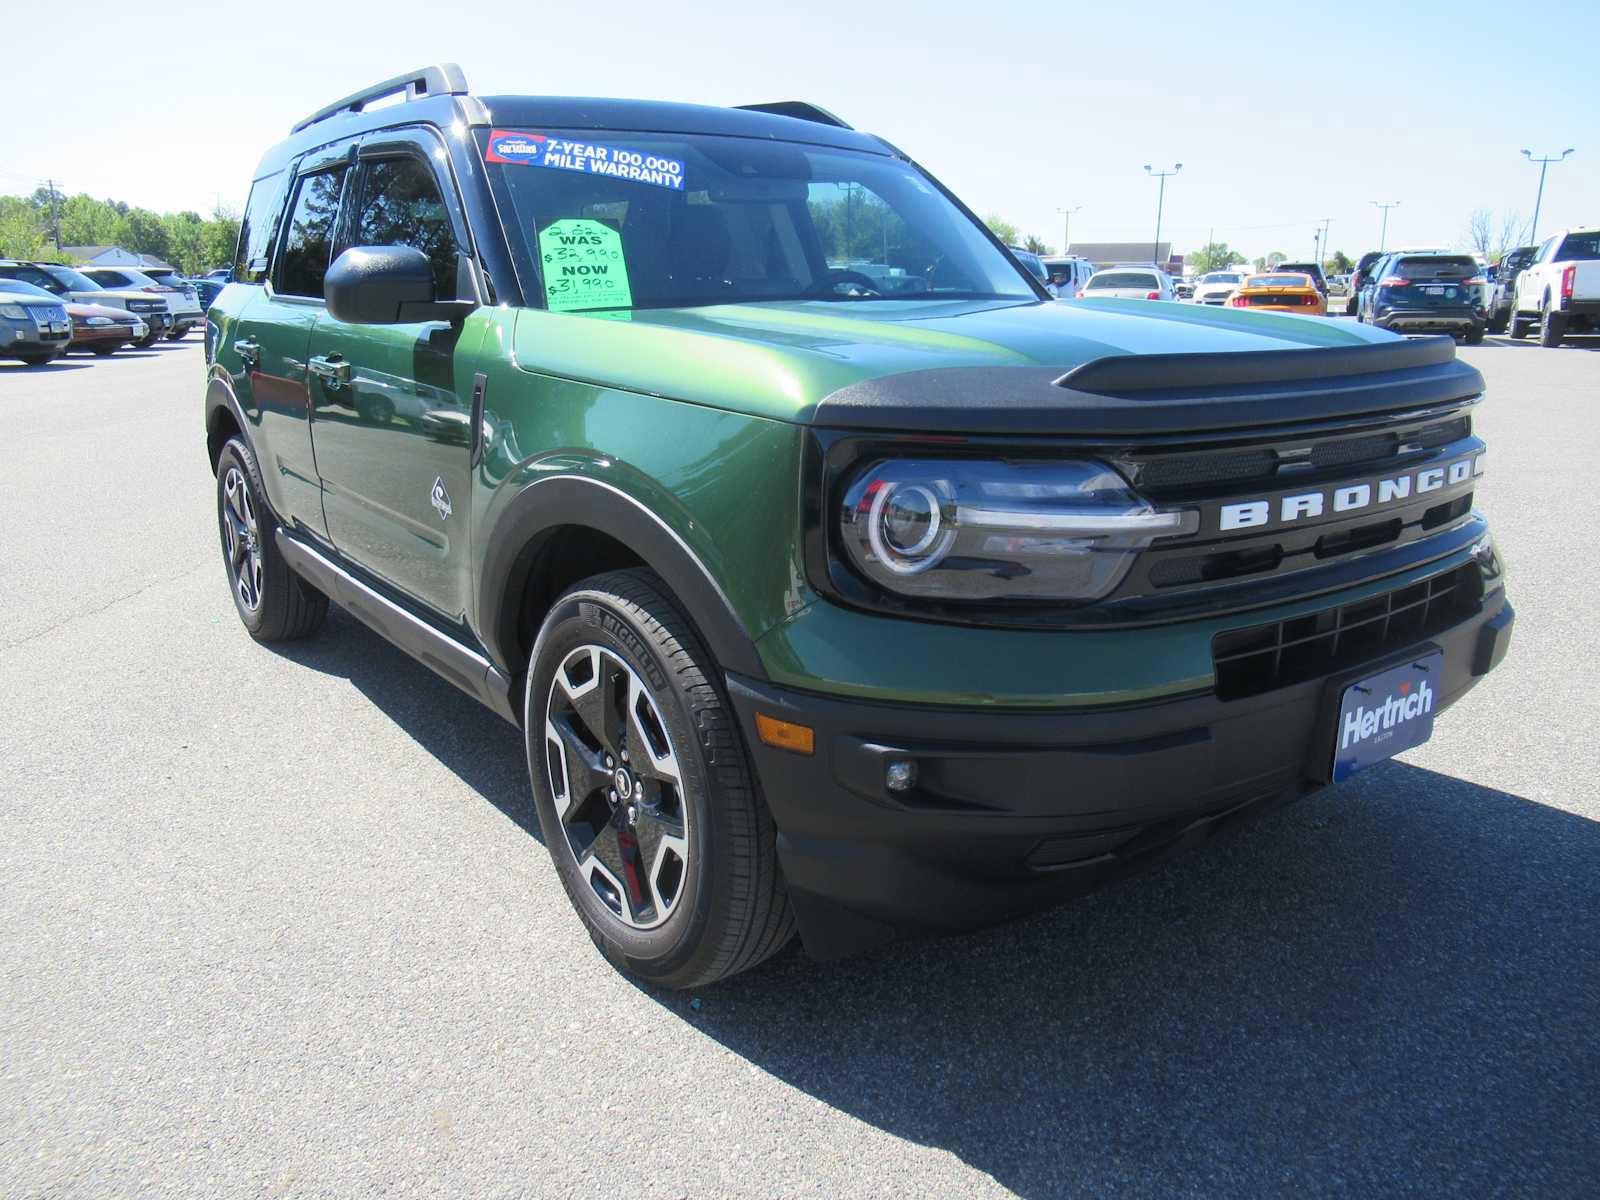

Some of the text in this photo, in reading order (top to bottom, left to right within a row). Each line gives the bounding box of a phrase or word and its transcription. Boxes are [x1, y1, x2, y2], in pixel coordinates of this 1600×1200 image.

[544, 152, 683, 188] MILE WARRANTY
[547, 140, 681, 175] 7-YEAR 100,000
[560, 236, 603, 245] WAS
[562, 265, 608, 276] NOW
[1219, 460, 1471, 531] BRONCO
[602, 614, 664, 691] MICHELIN
[1341, 679, 1433, 750] Hertrich
